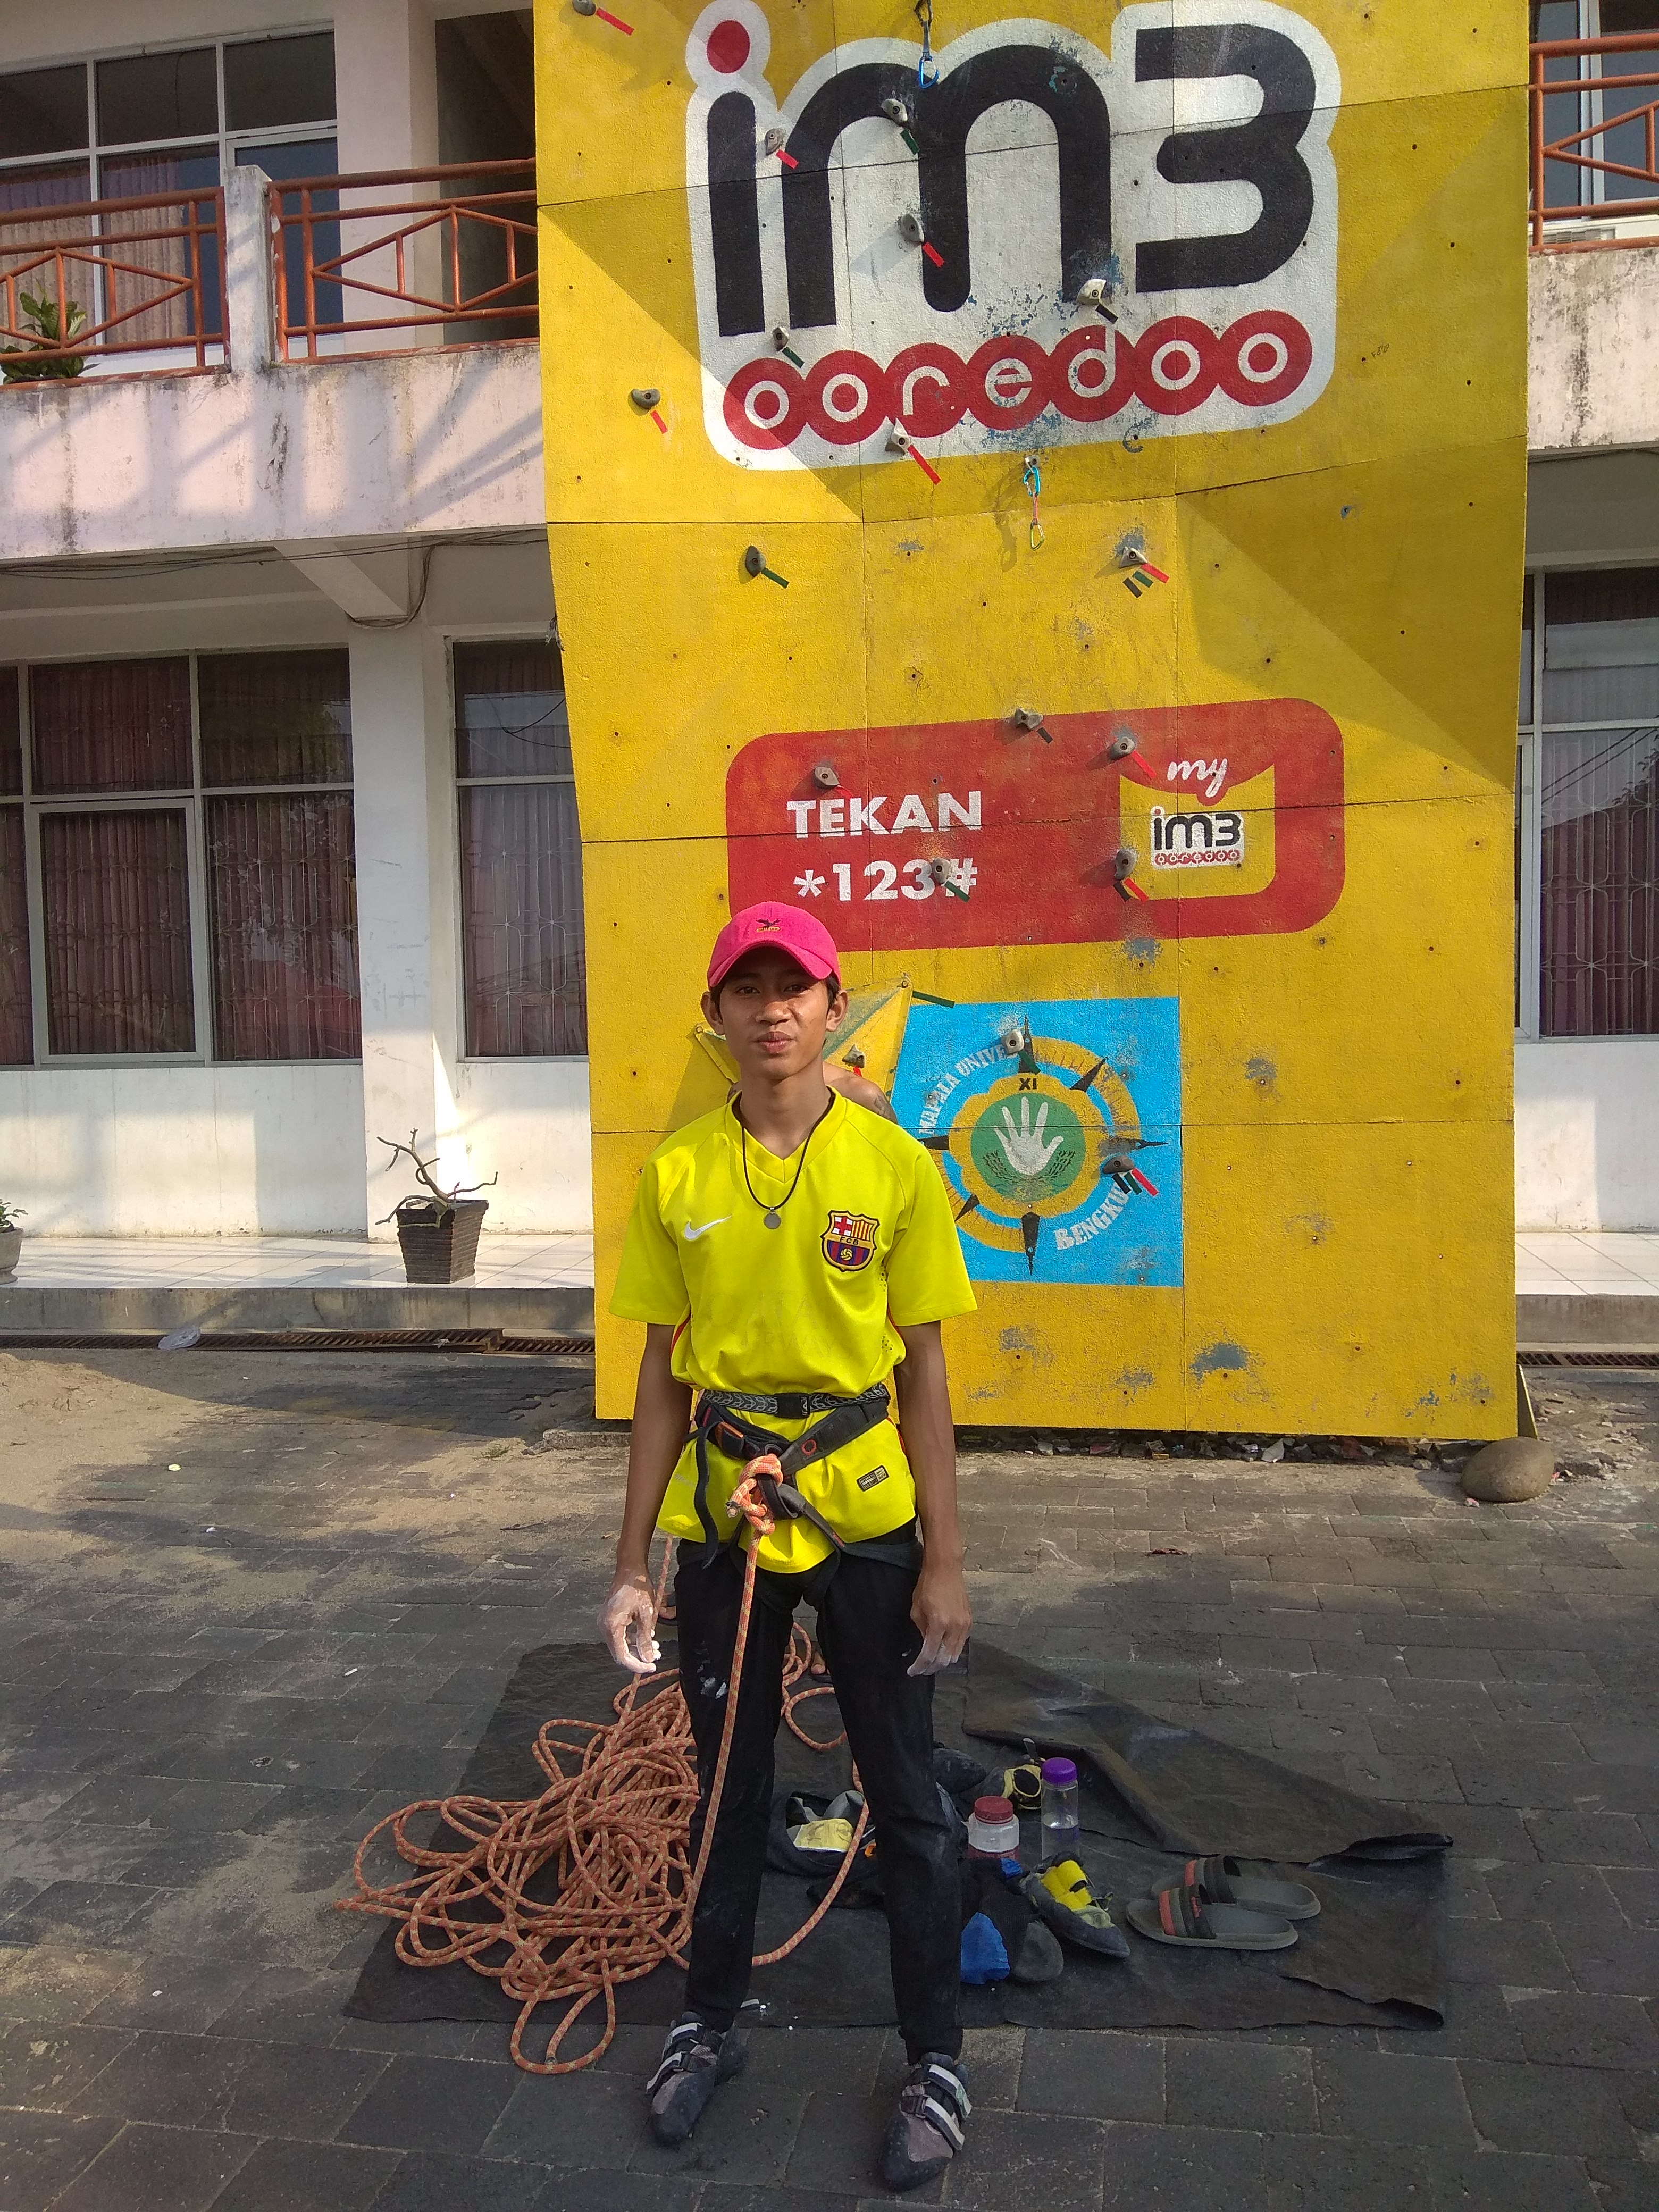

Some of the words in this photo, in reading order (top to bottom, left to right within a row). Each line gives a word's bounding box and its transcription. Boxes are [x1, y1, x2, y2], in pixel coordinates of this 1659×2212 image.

[707, 19, 1316, 337] im3
[743, 322, 1289, 429] ooredoo
[1167, 758, 1228, 798] my
[786, 791, 982, 839] TEKAN
[1153, 808, 1242, 851] im3
[1155, 850, 1239, 865] ooredoo
[1018, 1078, 1037, 1091] XI
[839, 1236, 859, 1245] FCB
